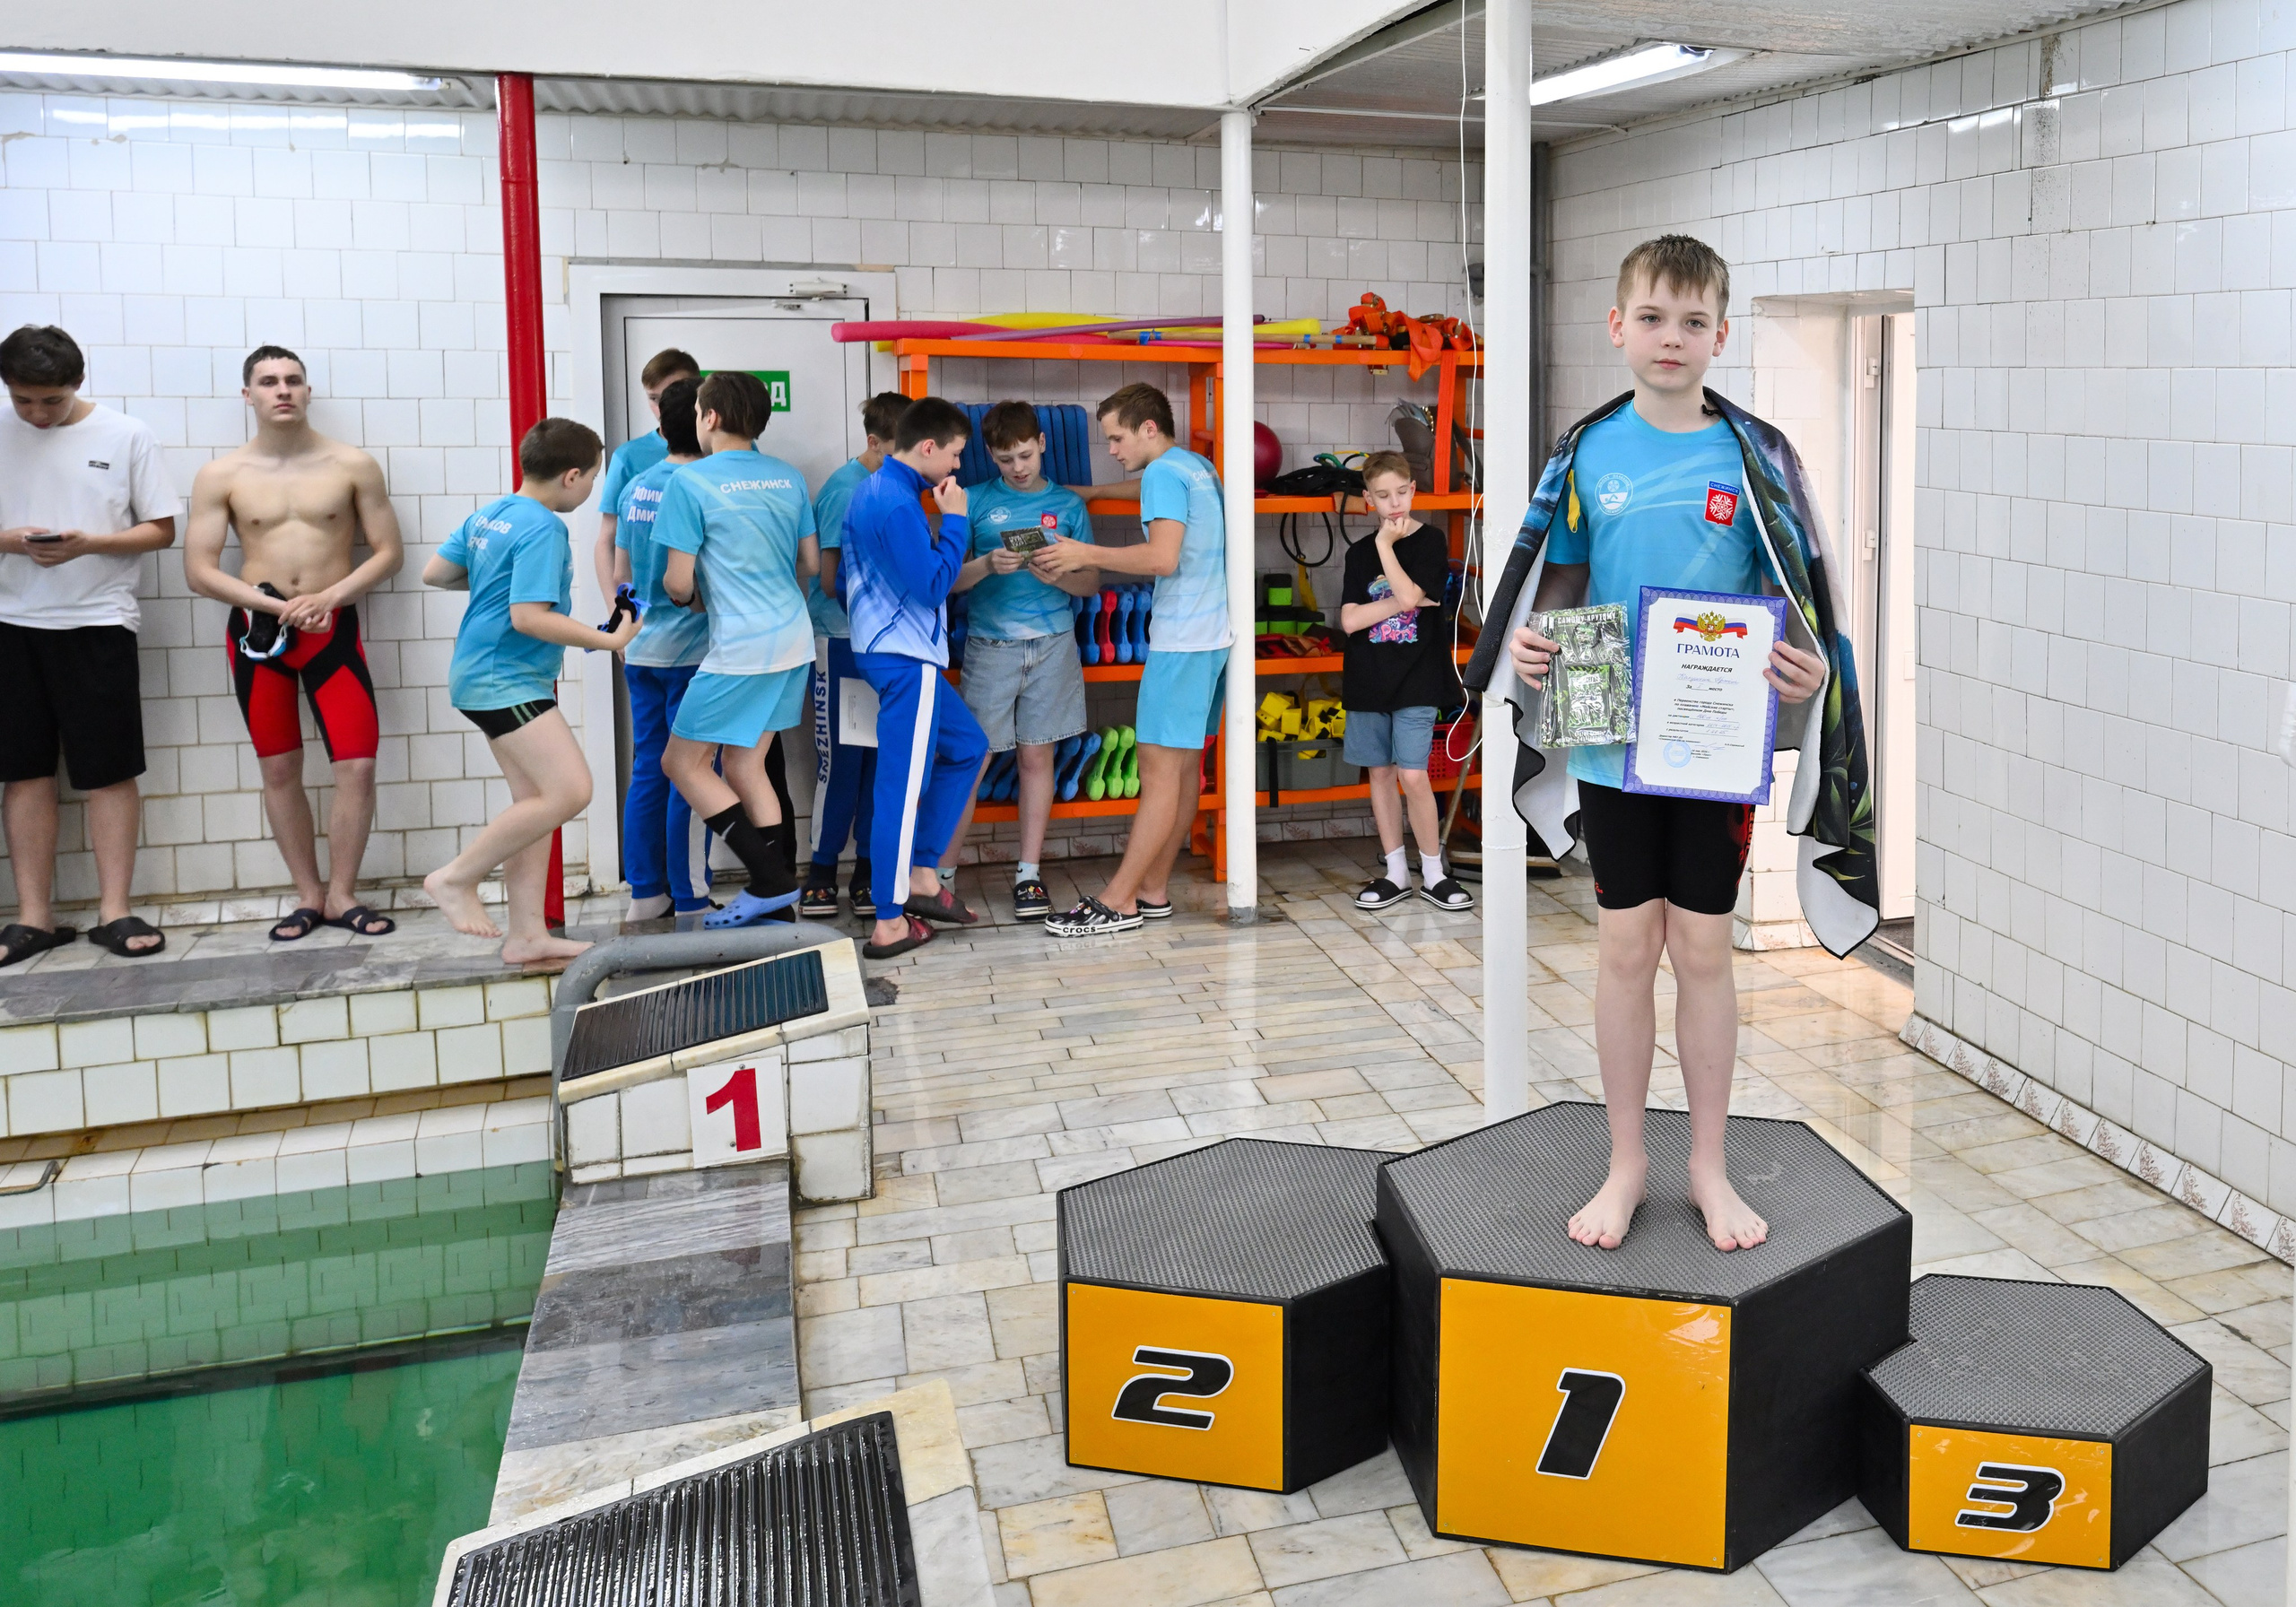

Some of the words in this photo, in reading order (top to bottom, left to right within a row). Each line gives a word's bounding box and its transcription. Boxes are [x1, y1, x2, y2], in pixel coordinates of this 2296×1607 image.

[719, 479, 793, 493] СНЕЖИНСК
[1710, 482, 1739, 493] СНЕЖИНСК
[1380, 624, 1415, 641] PARTY
[1676, 643, 1740, 658] ГРАМОТА
[1681, 664, 1733, 673] НАГРАЖДАЕТСЯ
[815, 671, 830, 784] SNEZHINSK
[1062, 925, 1096, 934] crocs
[705, 1067, 762, 1152] 1
[1111, 1344, 1234, 1430] 2
[1536, 1367, 1625, 1480] 1
[1955, 1461, 2065, 1532] 3
